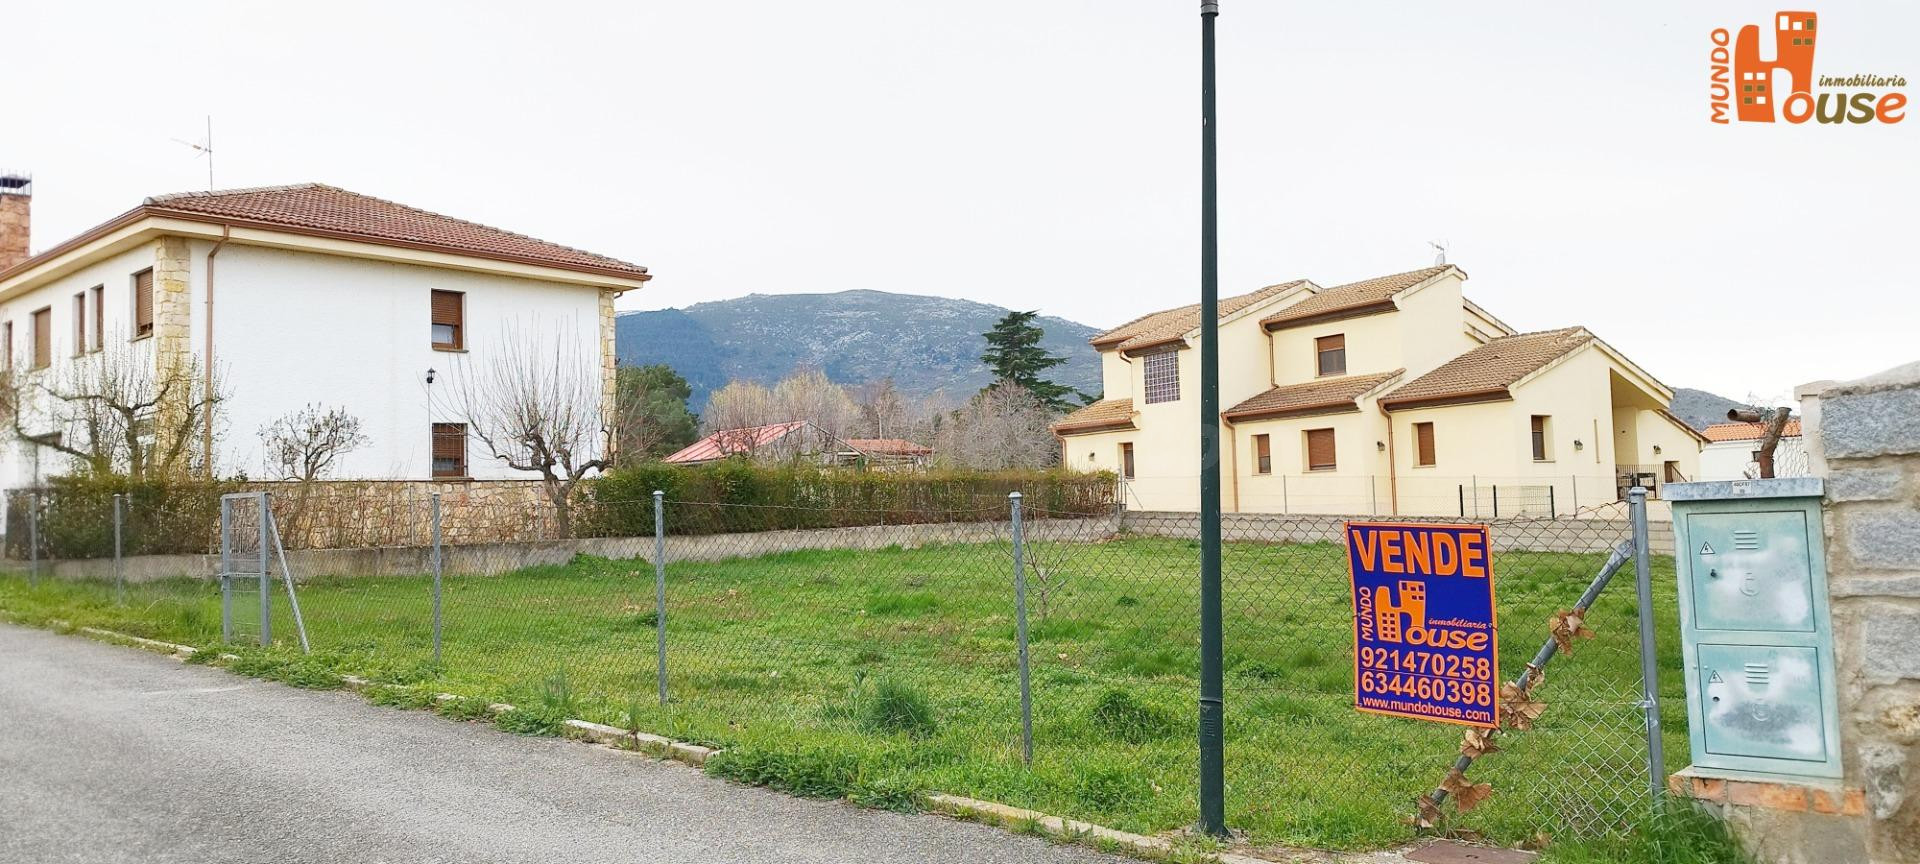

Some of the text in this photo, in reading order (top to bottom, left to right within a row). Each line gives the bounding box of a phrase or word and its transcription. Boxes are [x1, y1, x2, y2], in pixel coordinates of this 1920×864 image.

[1352, 530, 1485, 577] VENDE
[1359, 586, 1373, 641] MUNDO
[1428, 617, 1487, 630] inmobiliaria
[1361, 646, 1491, 681] 921470258
[1361, 672, 1491, 706] 634460398
[1362, 696, 1490, 722] www.mundohouse.com
